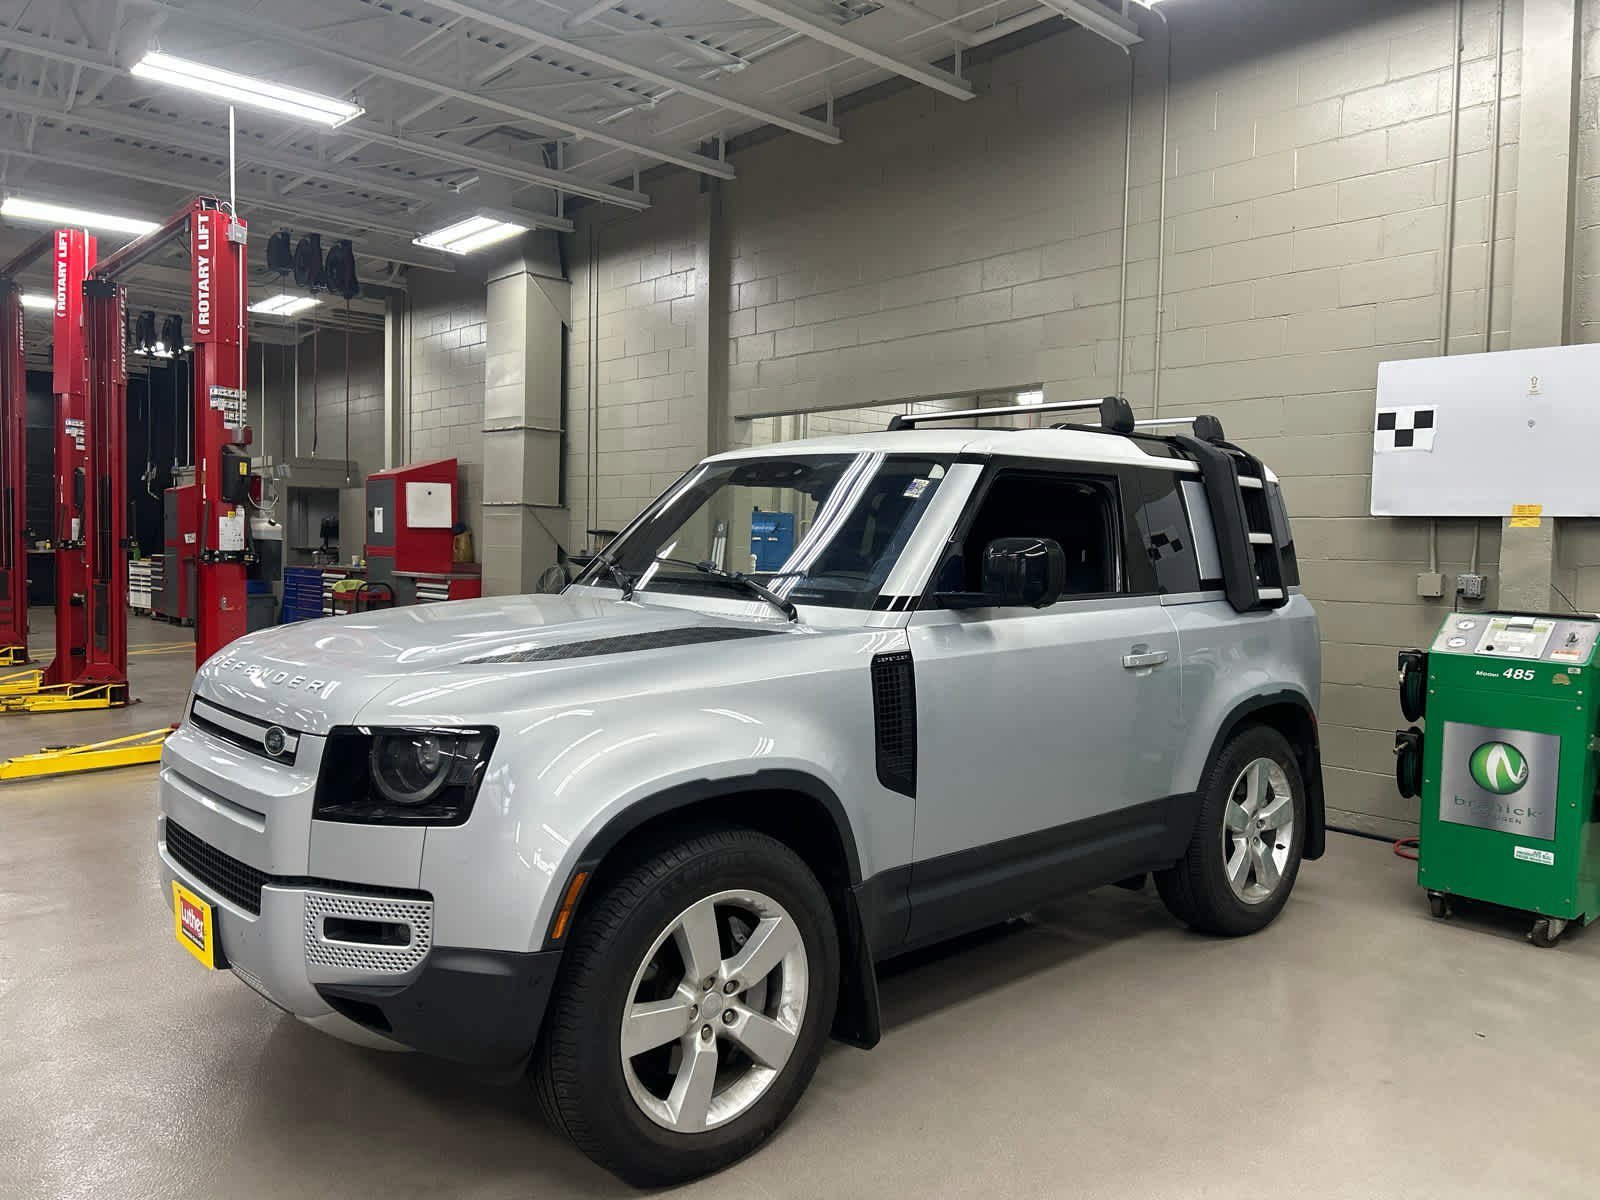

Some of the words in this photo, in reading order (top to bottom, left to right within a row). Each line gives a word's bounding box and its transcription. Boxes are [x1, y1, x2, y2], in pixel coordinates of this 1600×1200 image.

[58, 232, 68, 258] LIFT
[198, 213, 210, 250] LIFT
[57, 261, 68, 311] ROTARY
[198, 256, 210, 325] ROTARY
[211, 655, 326, 695] DEFENDER
[1503, 667, 1536, 681] 485
